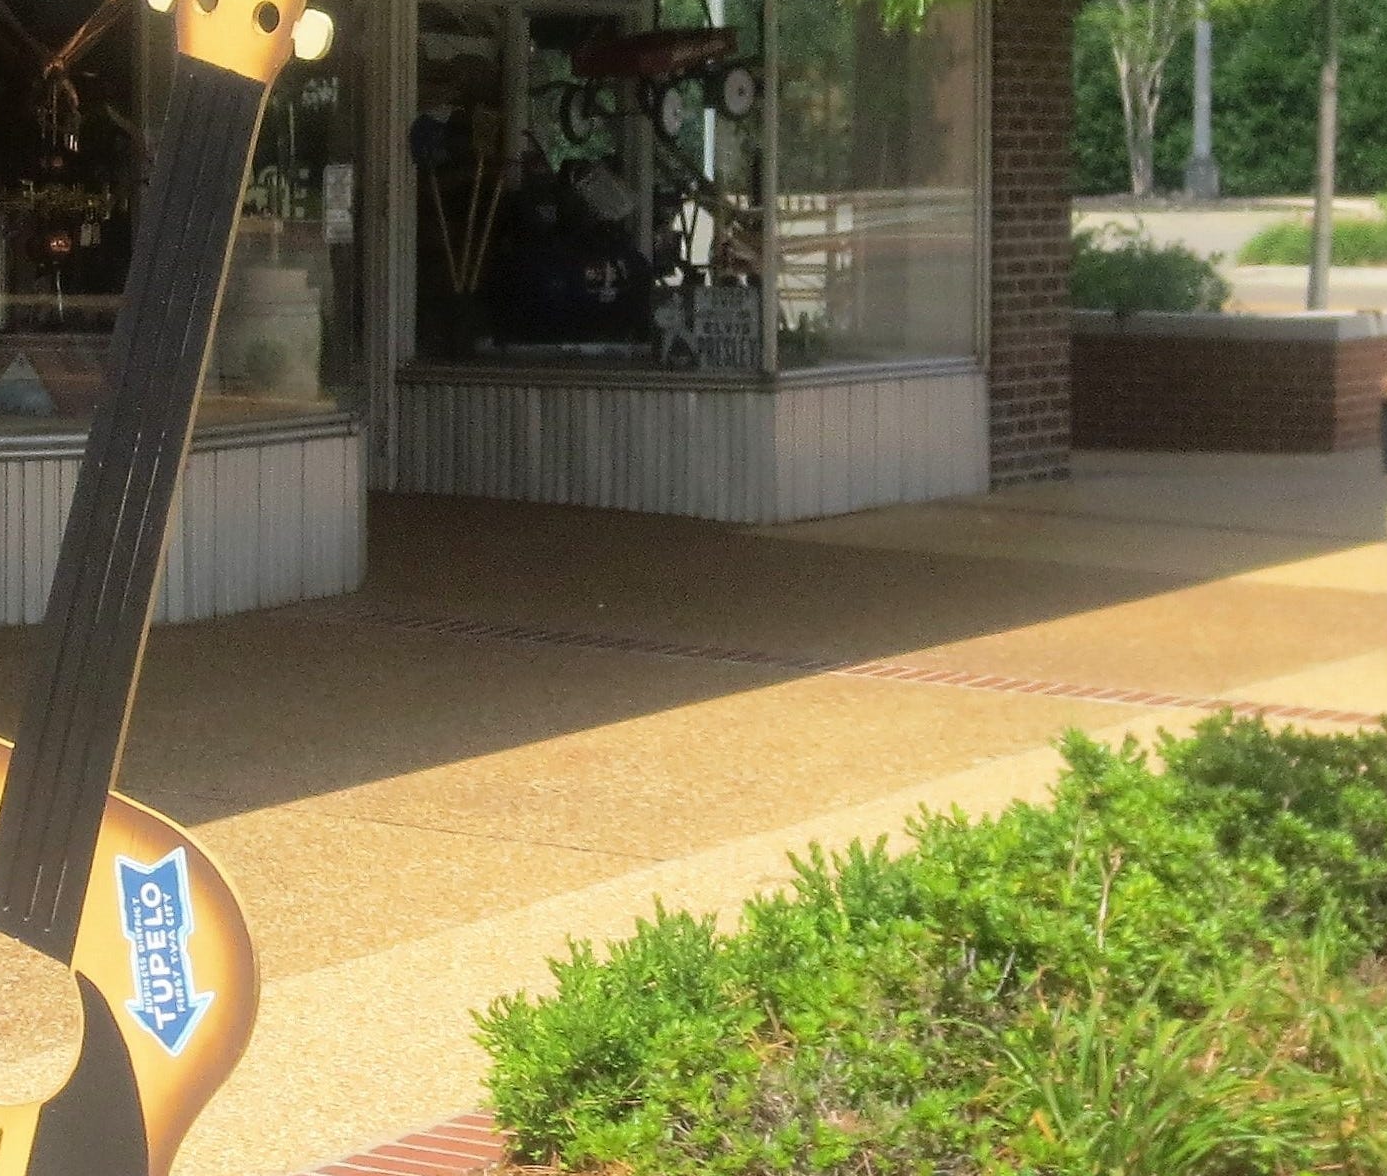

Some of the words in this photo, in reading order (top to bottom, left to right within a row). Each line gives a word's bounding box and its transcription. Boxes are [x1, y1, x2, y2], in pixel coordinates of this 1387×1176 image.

[163, 893, 174, 927] CITY
[140, 882, 177, 1030] TUPELO
[167, 929, 180, 964] TVA
[139, 956, 154, 1014] BUSINESS
[172, 971, 187, 1013] FIRST
